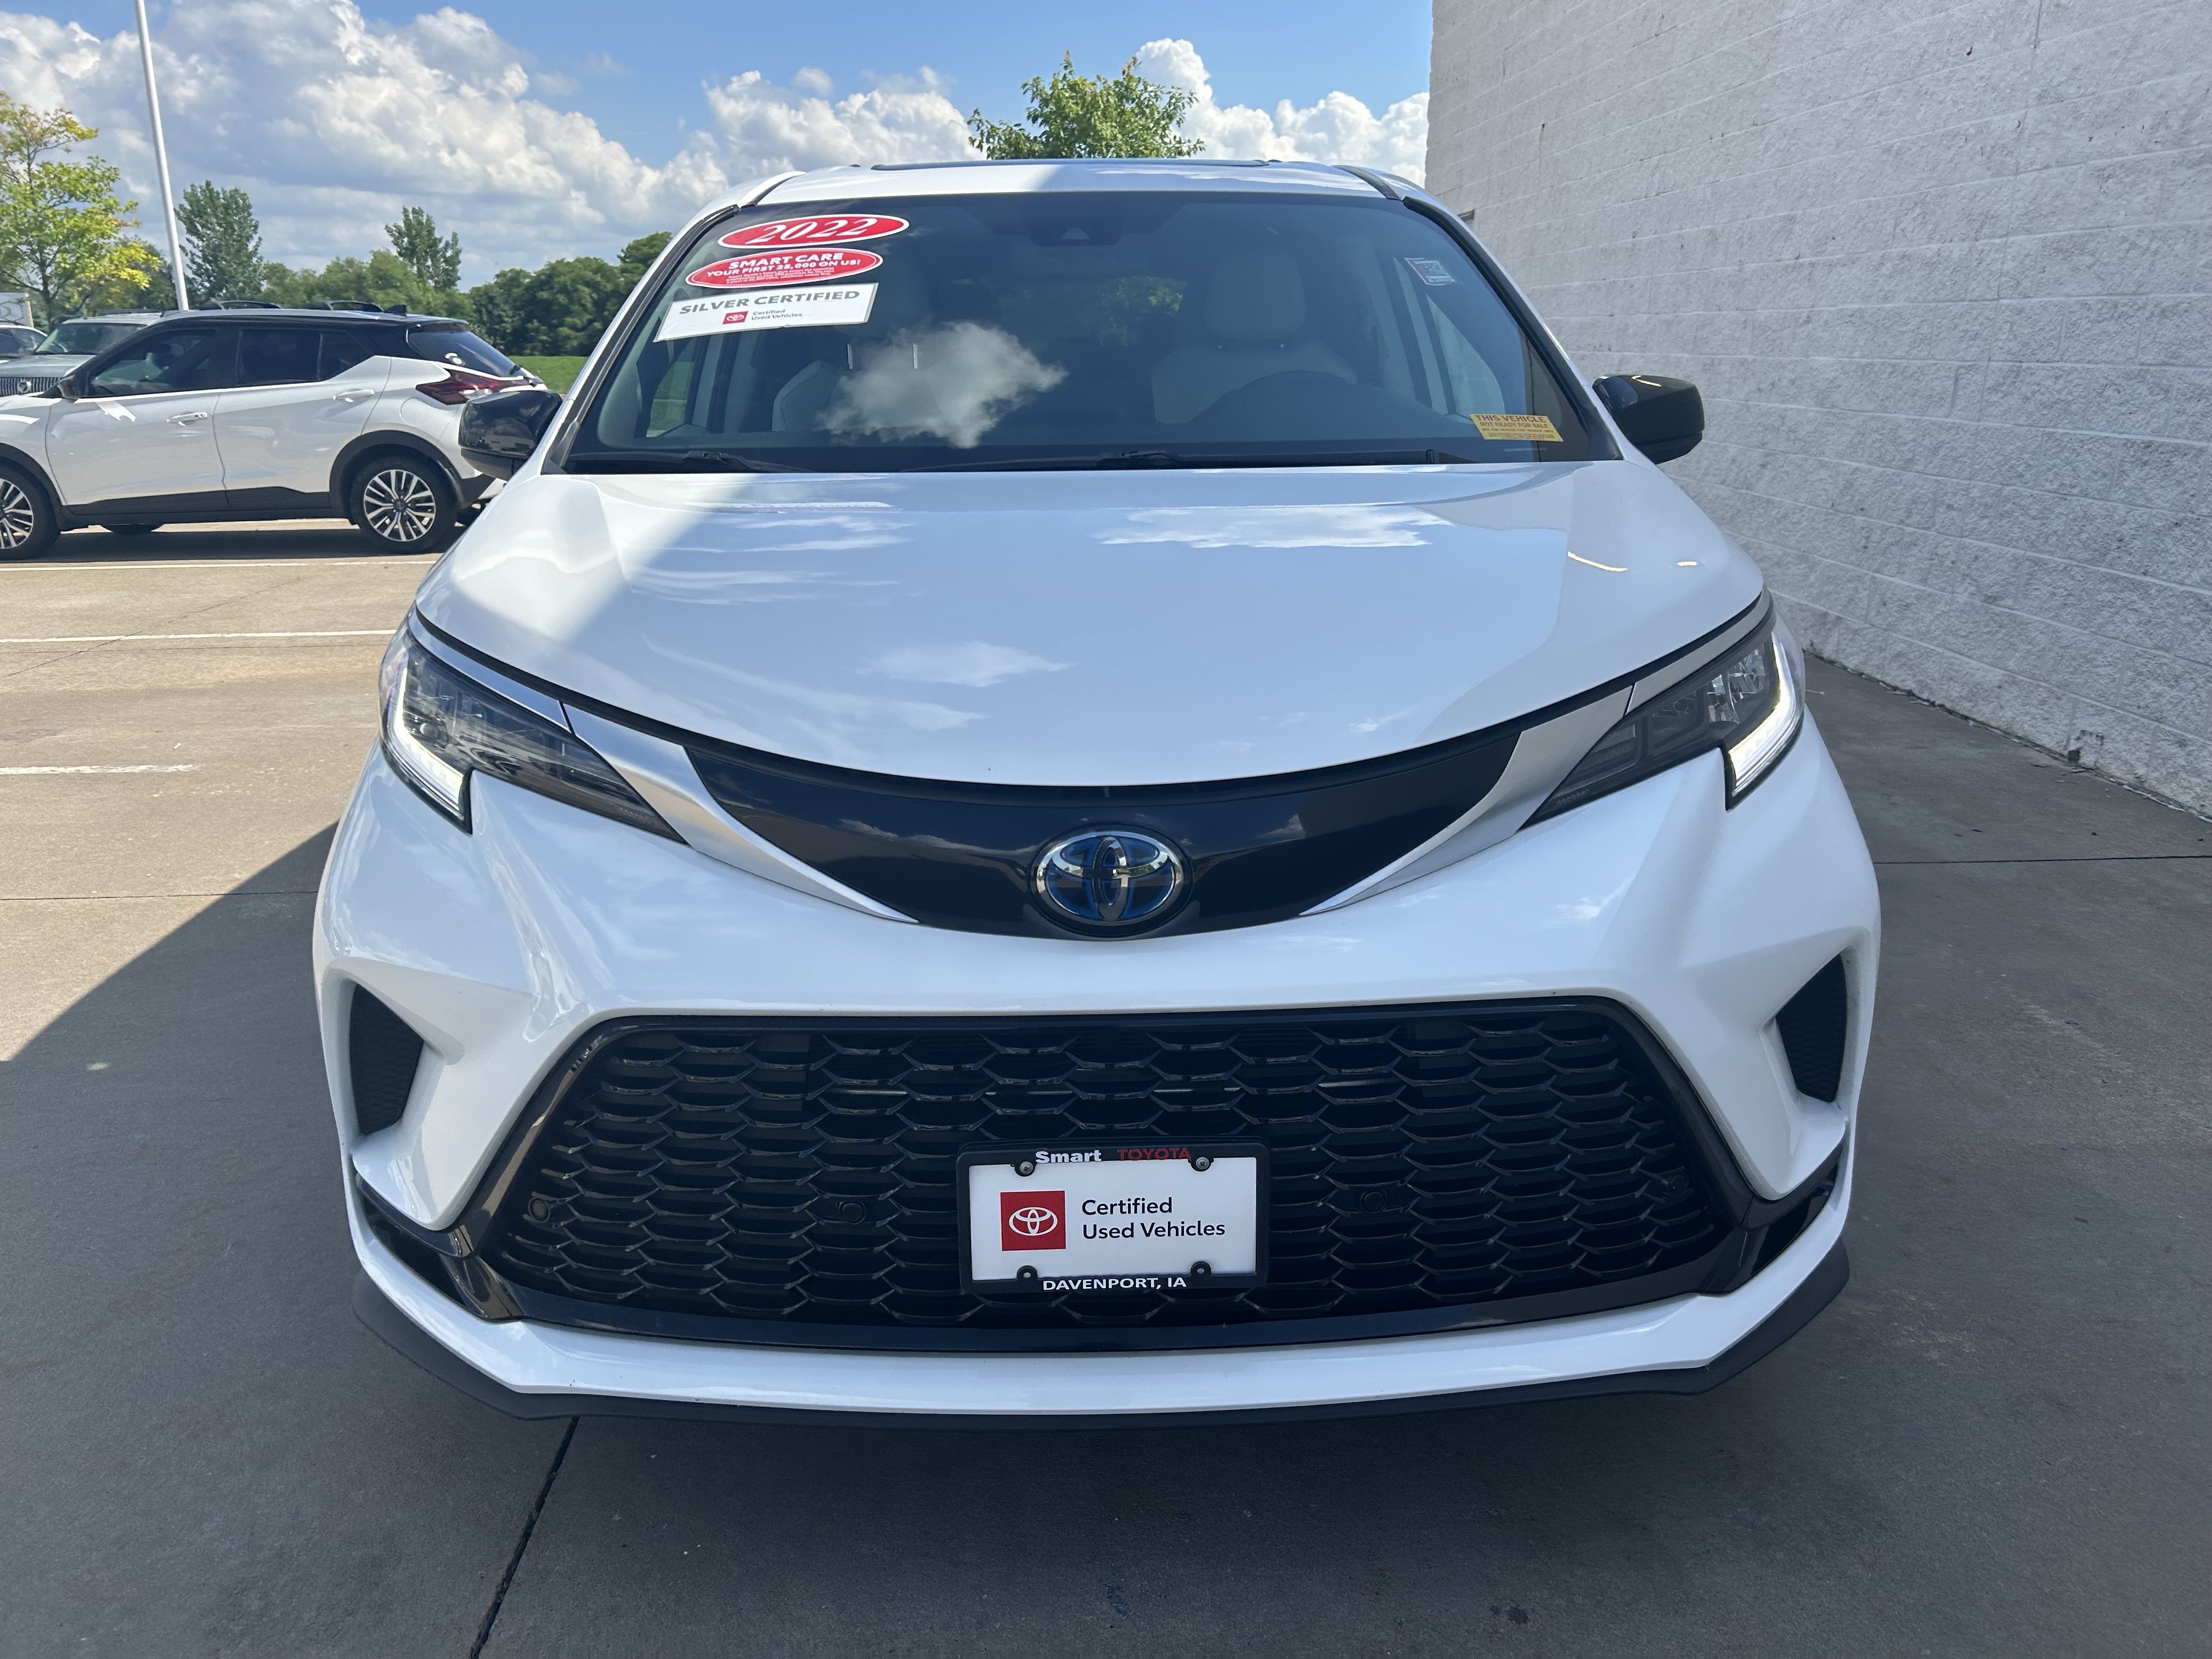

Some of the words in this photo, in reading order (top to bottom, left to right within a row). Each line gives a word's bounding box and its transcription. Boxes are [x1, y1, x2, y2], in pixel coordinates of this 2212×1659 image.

[744, 218, 879, 245] 2022
[729, 256, 793, 269] SMART
[795, 252, 844, 262] CARE
[707, 269, 740, 277] YOUR
[742, 266, 775, 274] FIRST
[776, 262, 816, 270] 25,000
[679, 298, 749, 314] SILVER
[754, 291, 860, 305] CERTIFIED
[1500, 415, 1547, 423] VEHICLE
[1035, 1149, 1102, 1164] Smart
[1116, 1147, 1192, 1161] TOYOTA
[1081, 1197, 1173, 1216] Certified
[1082, 1222, 1134, 1240] Used
[1141, 1220, 1226, 1238] Vehicles
[1043, 1277, 1161, 1291] DAVENPORT,
[1167, 1277, 1187, 1288] IA
